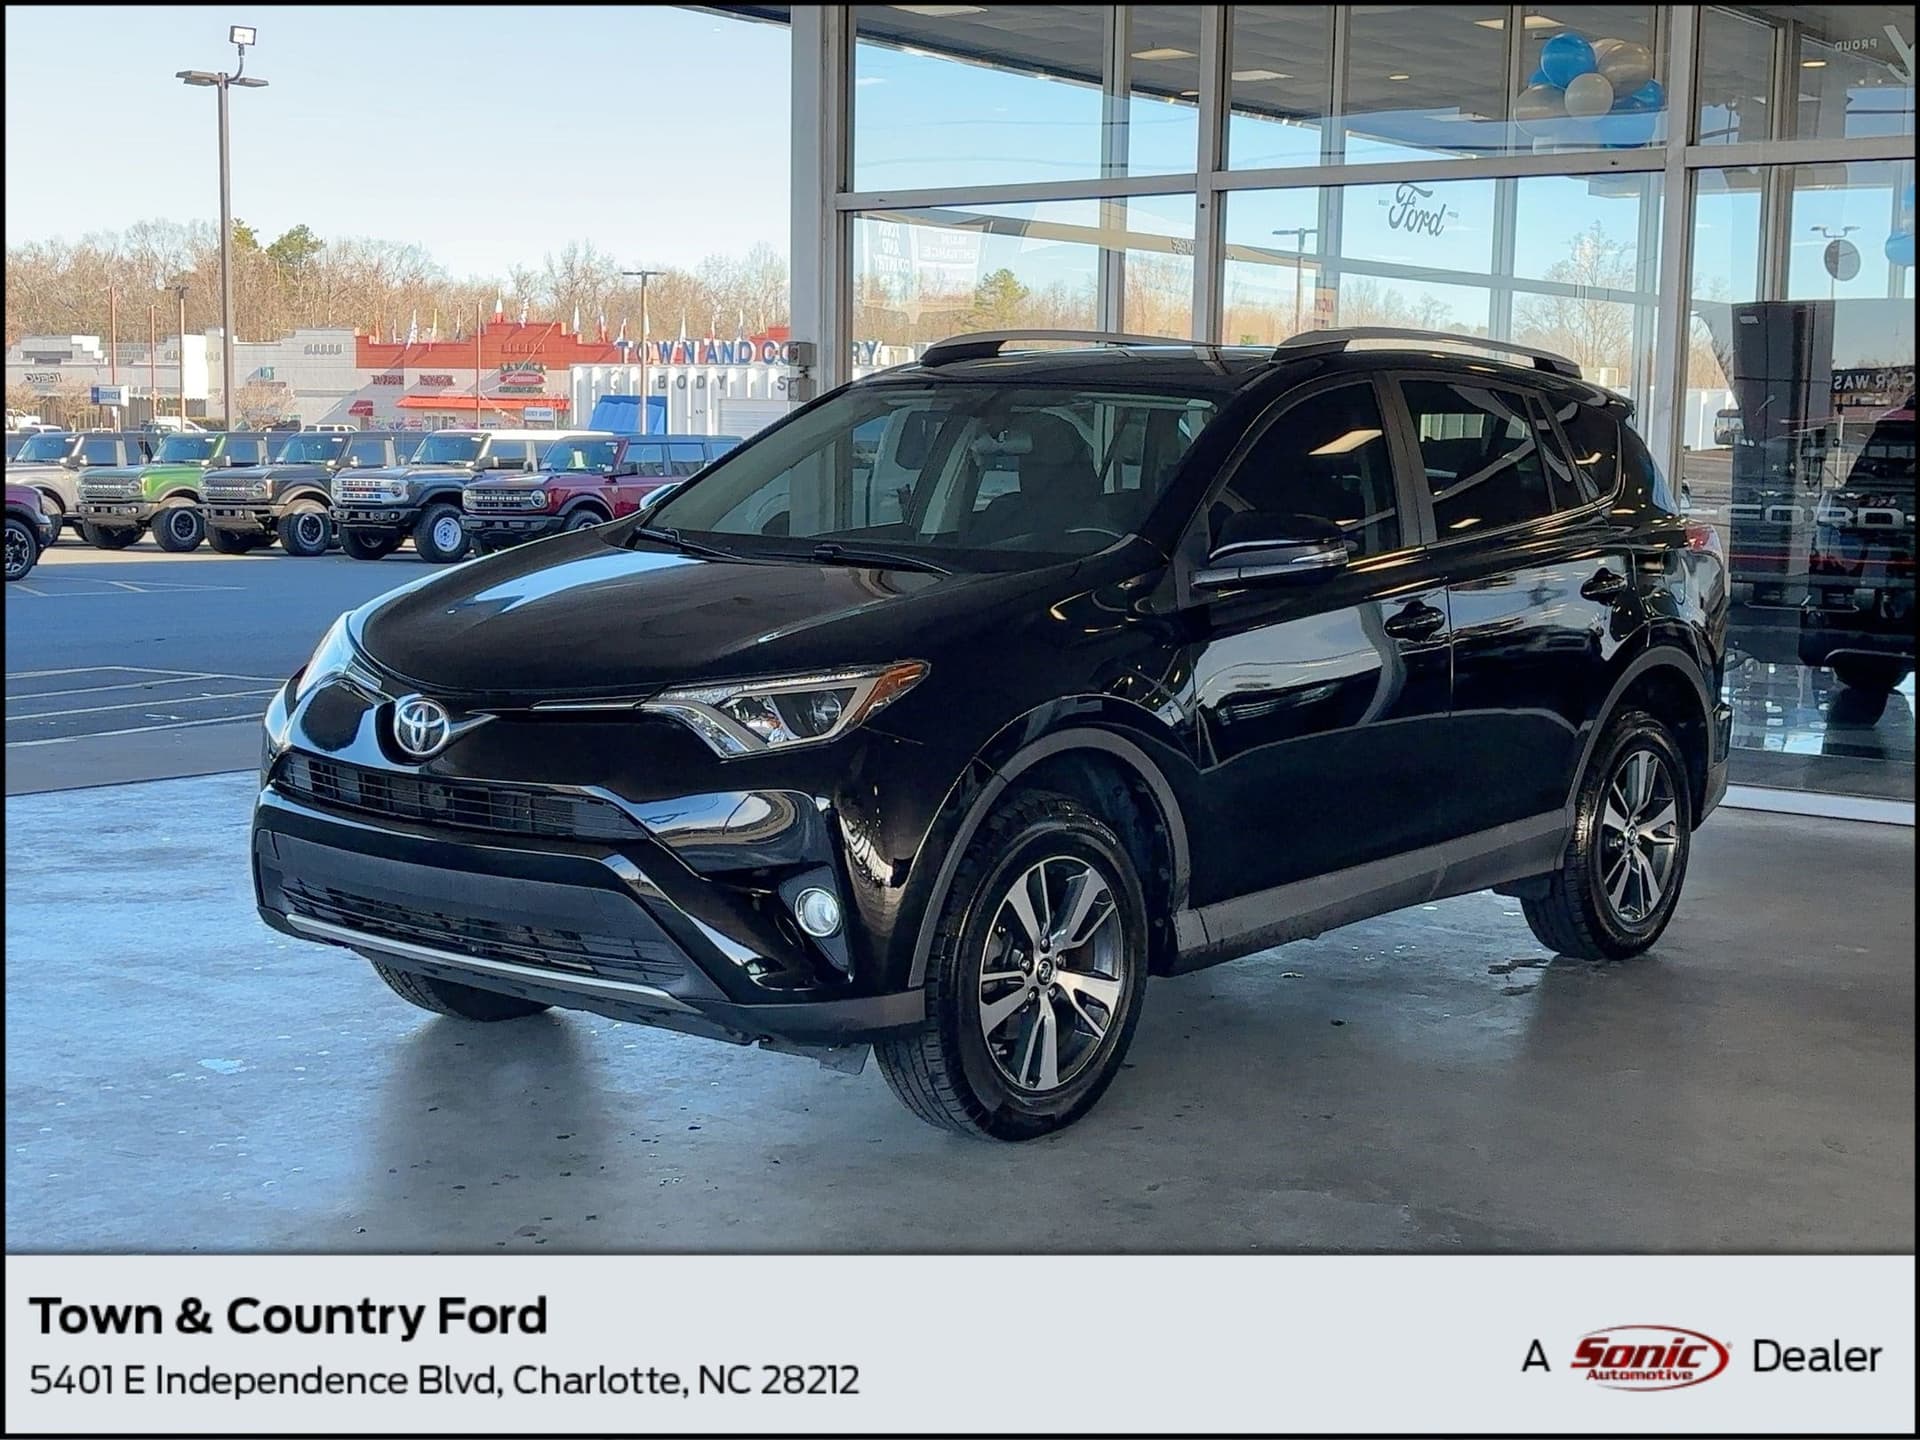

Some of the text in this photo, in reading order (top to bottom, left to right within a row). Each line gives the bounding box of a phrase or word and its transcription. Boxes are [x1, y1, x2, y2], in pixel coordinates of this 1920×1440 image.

[1388, 183, 1447, 236] Ford
[617, 341, 697, 364] TOWN
[705, 340, 753, 364] AND
[658, 375, 726, 390] BODY
[1719, 503, 1904, 529] FORD
